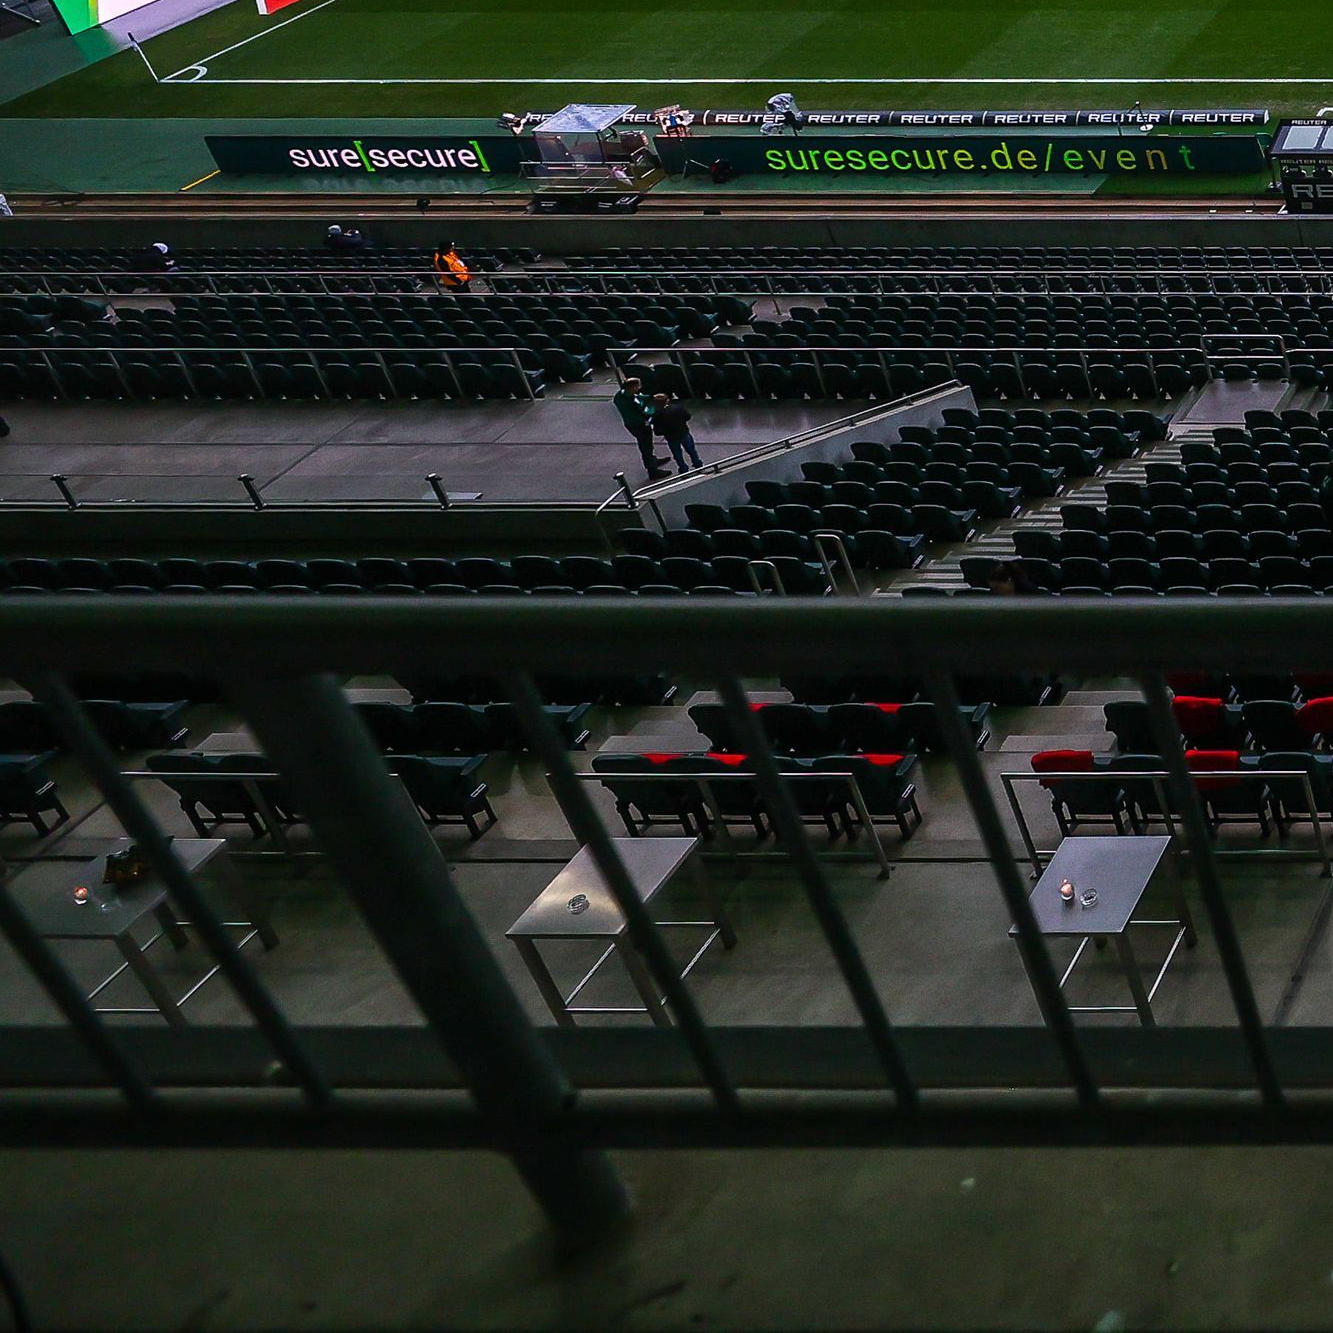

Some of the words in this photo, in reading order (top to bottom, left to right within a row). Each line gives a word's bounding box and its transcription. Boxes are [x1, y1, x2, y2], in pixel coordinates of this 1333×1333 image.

[807, 113, 882, 125] REUTER
[1181, 113, 1256, 125] REUTER
[289, 139, 492, 173] sure[secure]
